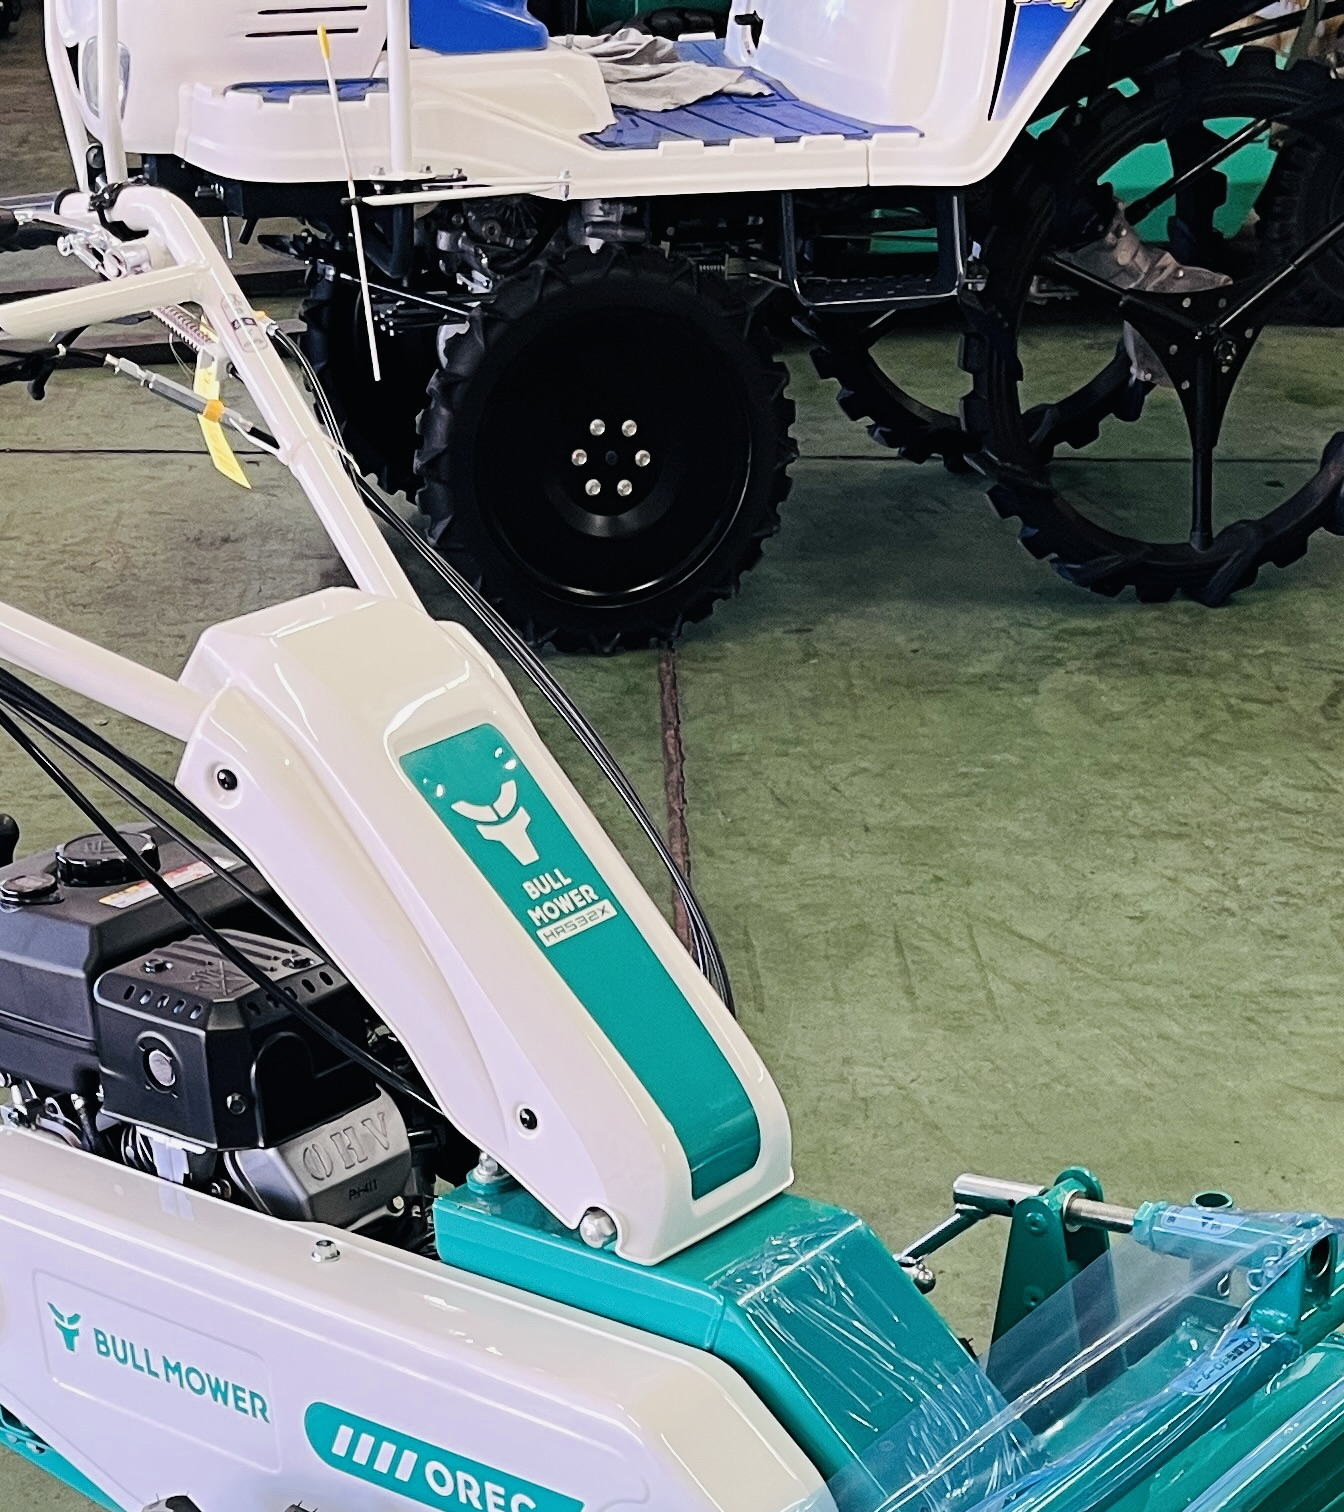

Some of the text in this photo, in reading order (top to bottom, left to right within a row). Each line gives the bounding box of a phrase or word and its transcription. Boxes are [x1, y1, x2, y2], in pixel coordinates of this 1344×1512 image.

[522, 868, 572, 900] BULL
[527, 884, 599, 927] MOWER
[302, 1111, 390, 1181] OHV
[94, 1327, 271, 1424] BULL MOWER
